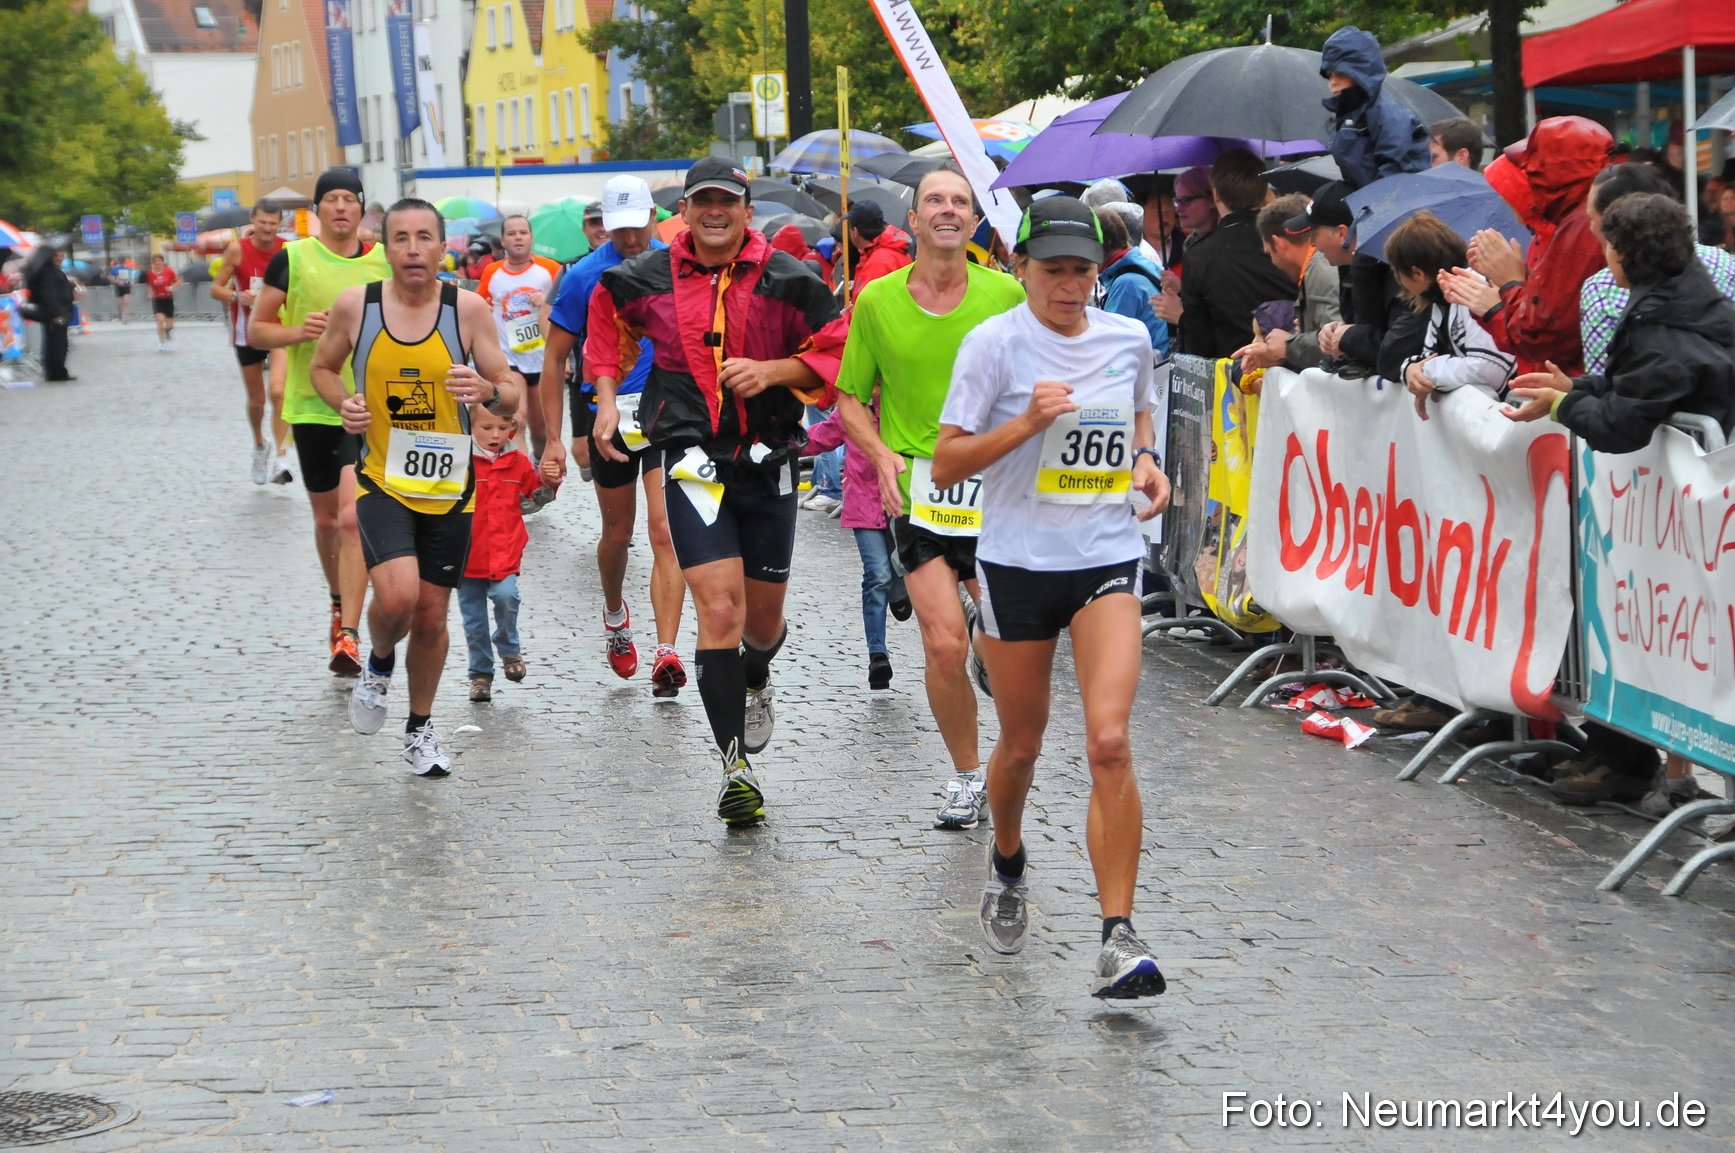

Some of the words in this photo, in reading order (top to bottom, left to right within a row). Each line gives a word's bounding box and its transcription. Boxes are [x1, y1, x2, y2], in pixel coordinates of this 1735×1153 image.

[398, 19, 413, 86] RUPPERT
[515, 323, 541, 343] 500
[392, 420, 436, 432] HIRSCH
[1061, 429, 1126, 468] 366
[403, 449, 454, 479] 808
[929, 509, 975, 526] Thomas
[1095, 576, 1129, 595] asics
